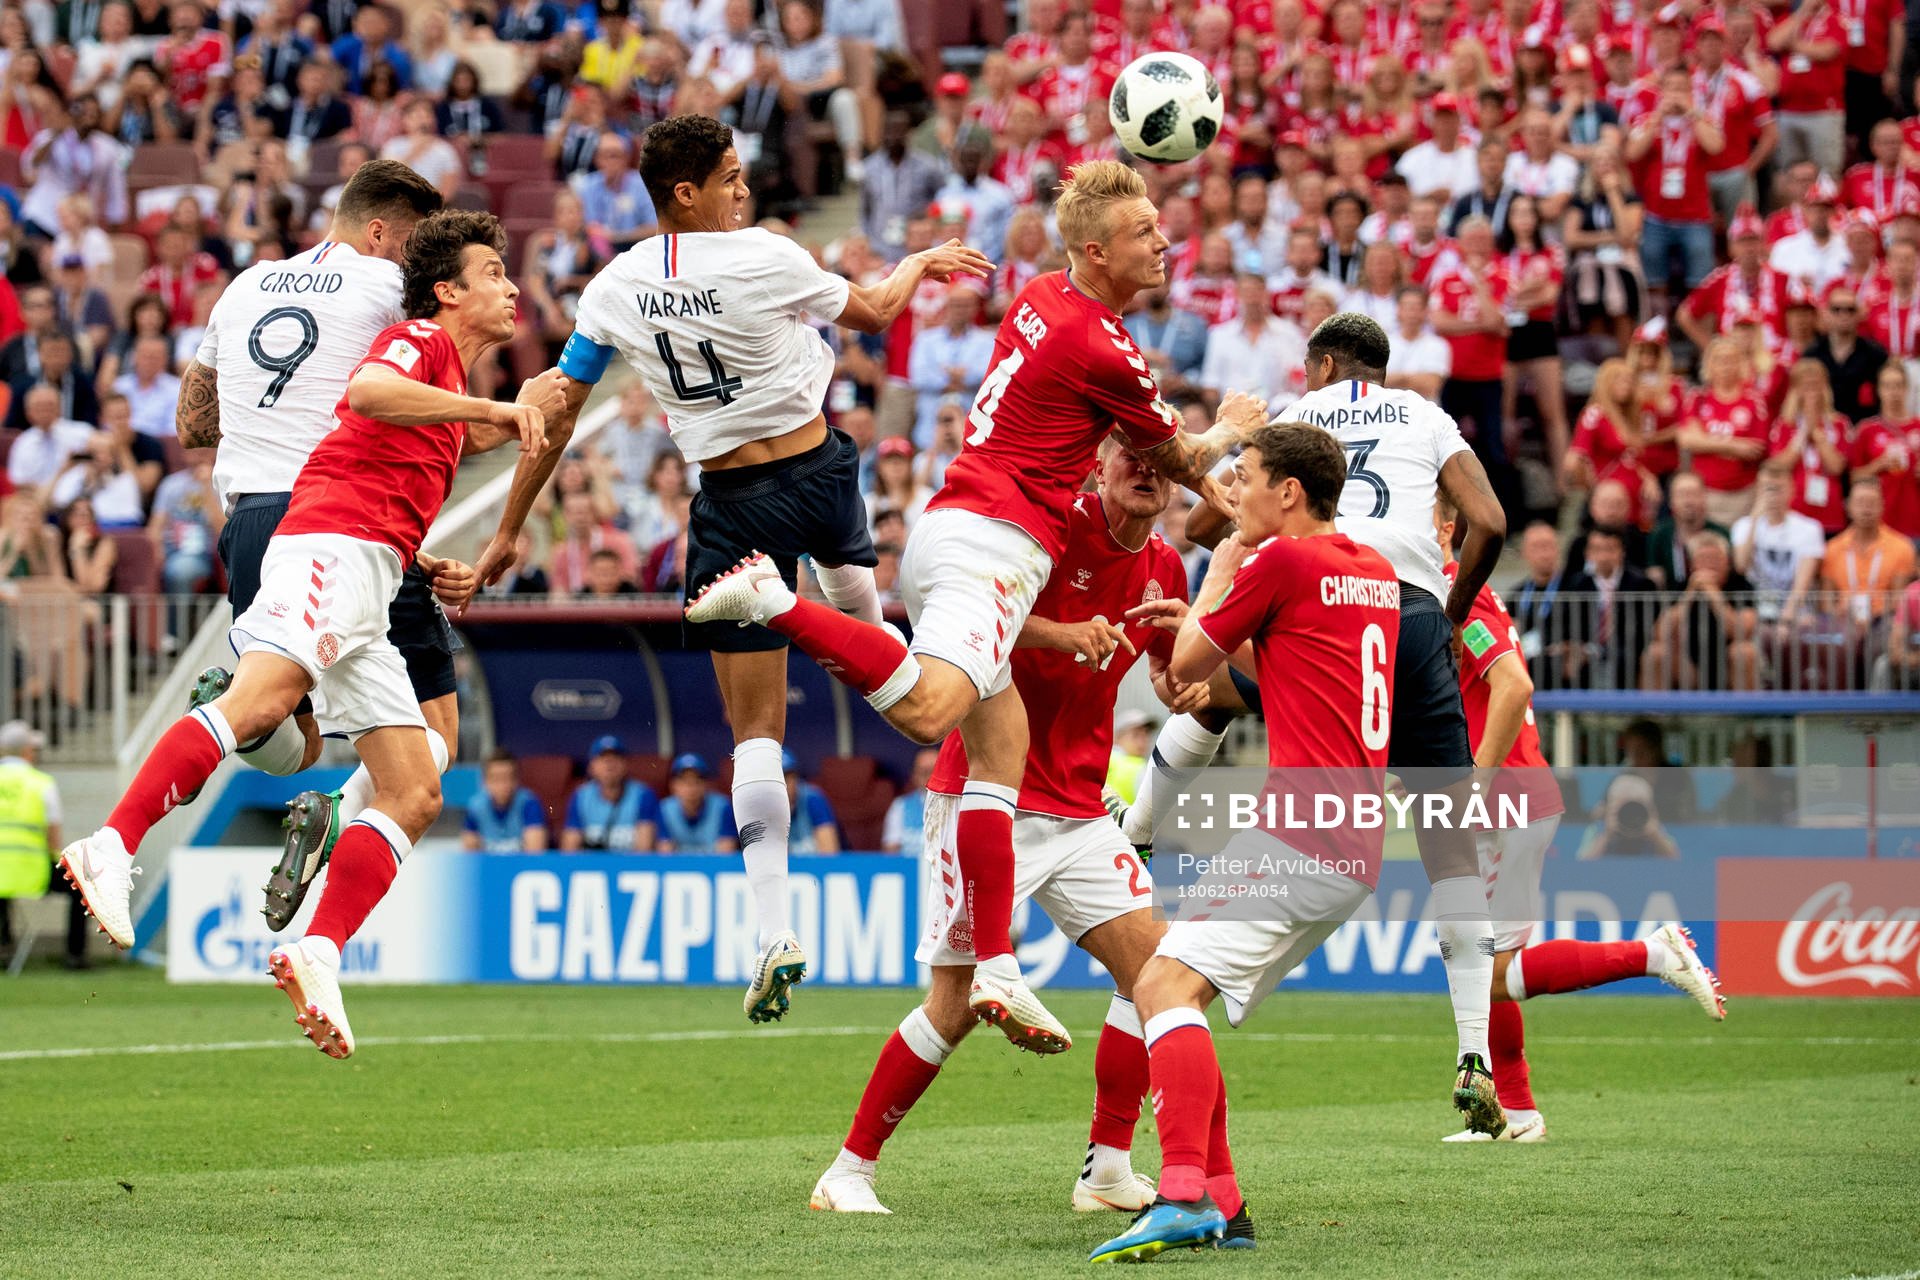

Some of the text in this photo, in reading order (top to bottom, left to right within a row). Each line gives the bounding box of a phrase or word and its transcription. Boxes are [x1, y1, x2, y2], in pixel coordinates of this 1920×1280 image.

[260, 272, 343, 293] GIROUD
[636, 288, 723, 319] VARANE
[247, 306, 319, 408] 9
[654, 331, 743, 406] 4
[966, 346, 1025, 447] 4
[1338, 438, 1390, 519] 3
[1361, 623, 1390, 751] 6
[510, 871, 907, 982] GAZPROM
